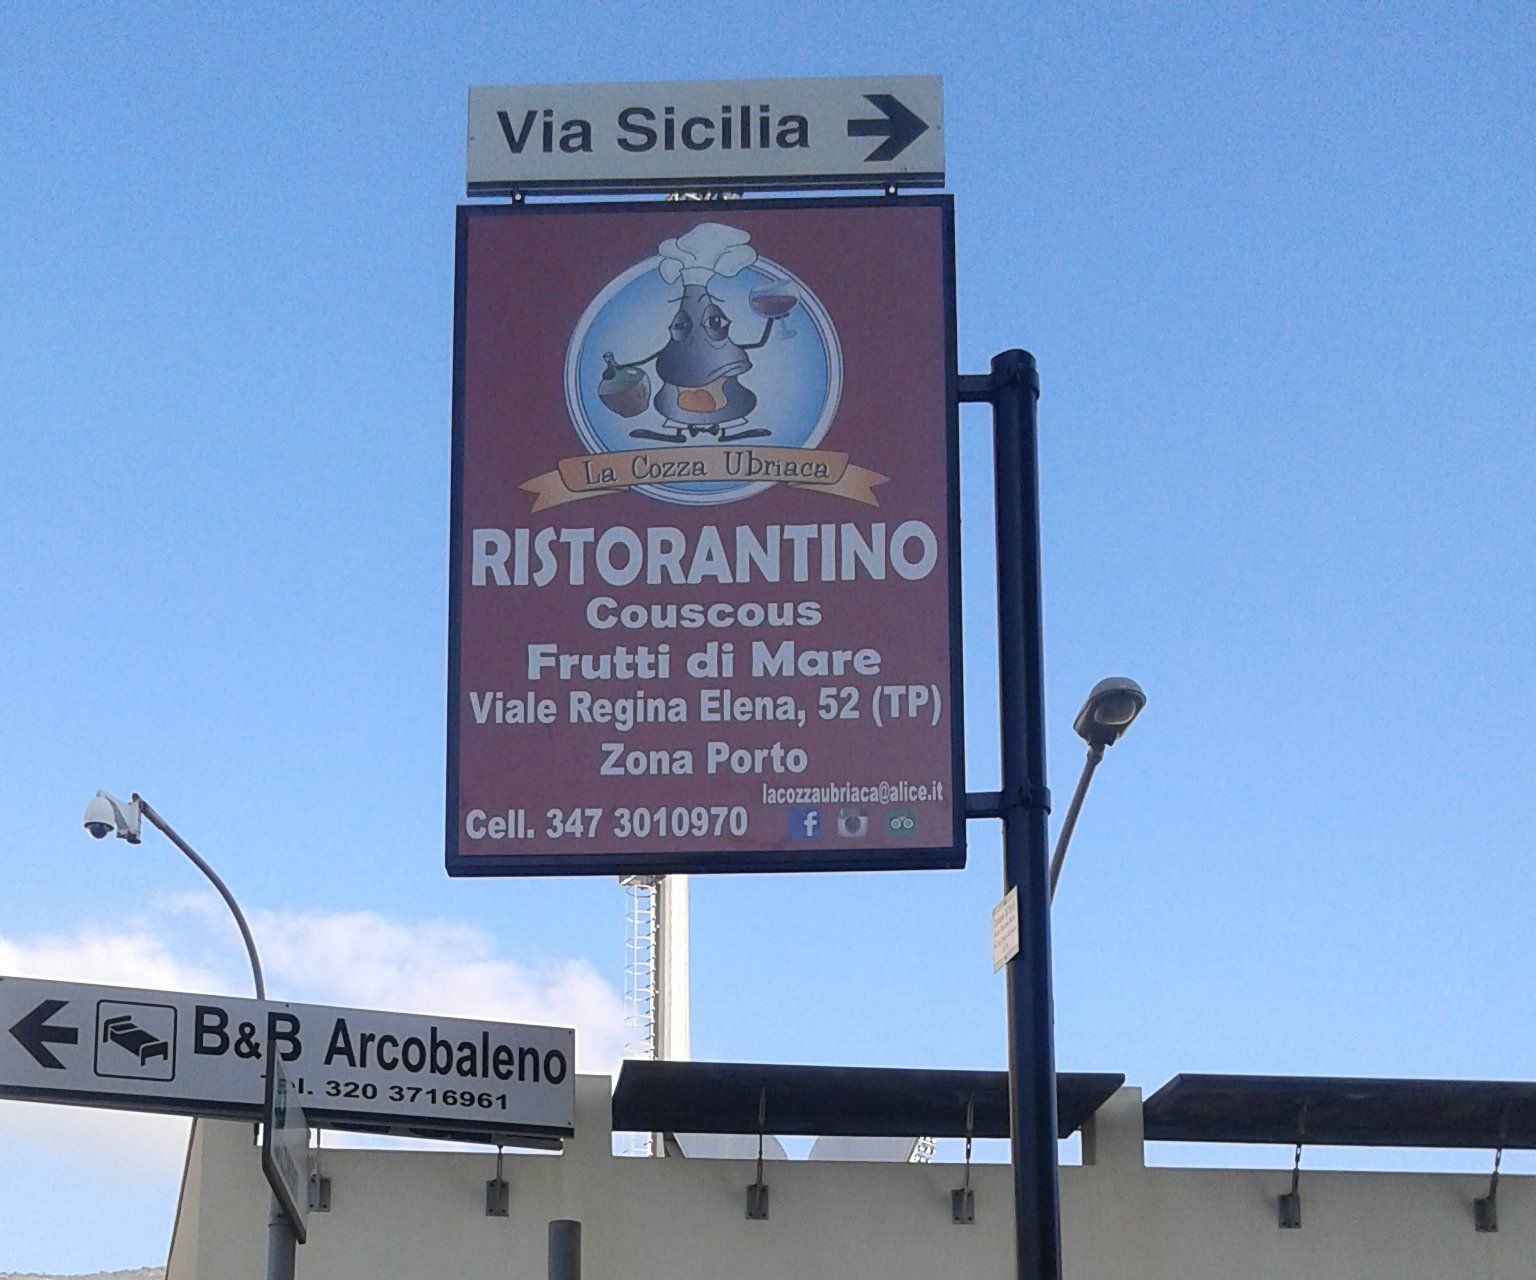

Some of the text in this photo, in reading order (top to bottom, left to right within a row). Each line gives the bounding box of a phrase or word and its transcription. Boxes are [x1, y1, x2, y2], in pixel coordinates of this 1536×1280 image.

[496, 104, 810, 154] Via Sicilia
[583, 451, 830, 486] La Cozza Ubriaca
[470, 519, 939, 587] RISTORANTINO
[586, 596, 823, 630] Couscous
[527, 639, 882, 680] Frutti di Mare
[469, 684, 942, 732] Viale Regina Elena, 52 (TP)
[600, 741, 808, 776] Zona Porto
[762, 780, 944, 805] lacozzaubriaca@alice.it
[465, 806, 748, 839] Cell. 347 3010970
[194, 1005, 568, 1086] B&B Arcobaleno
[325, 1080, 378, 1101] 320
[388, 1085, 508, 1111] 3716961
